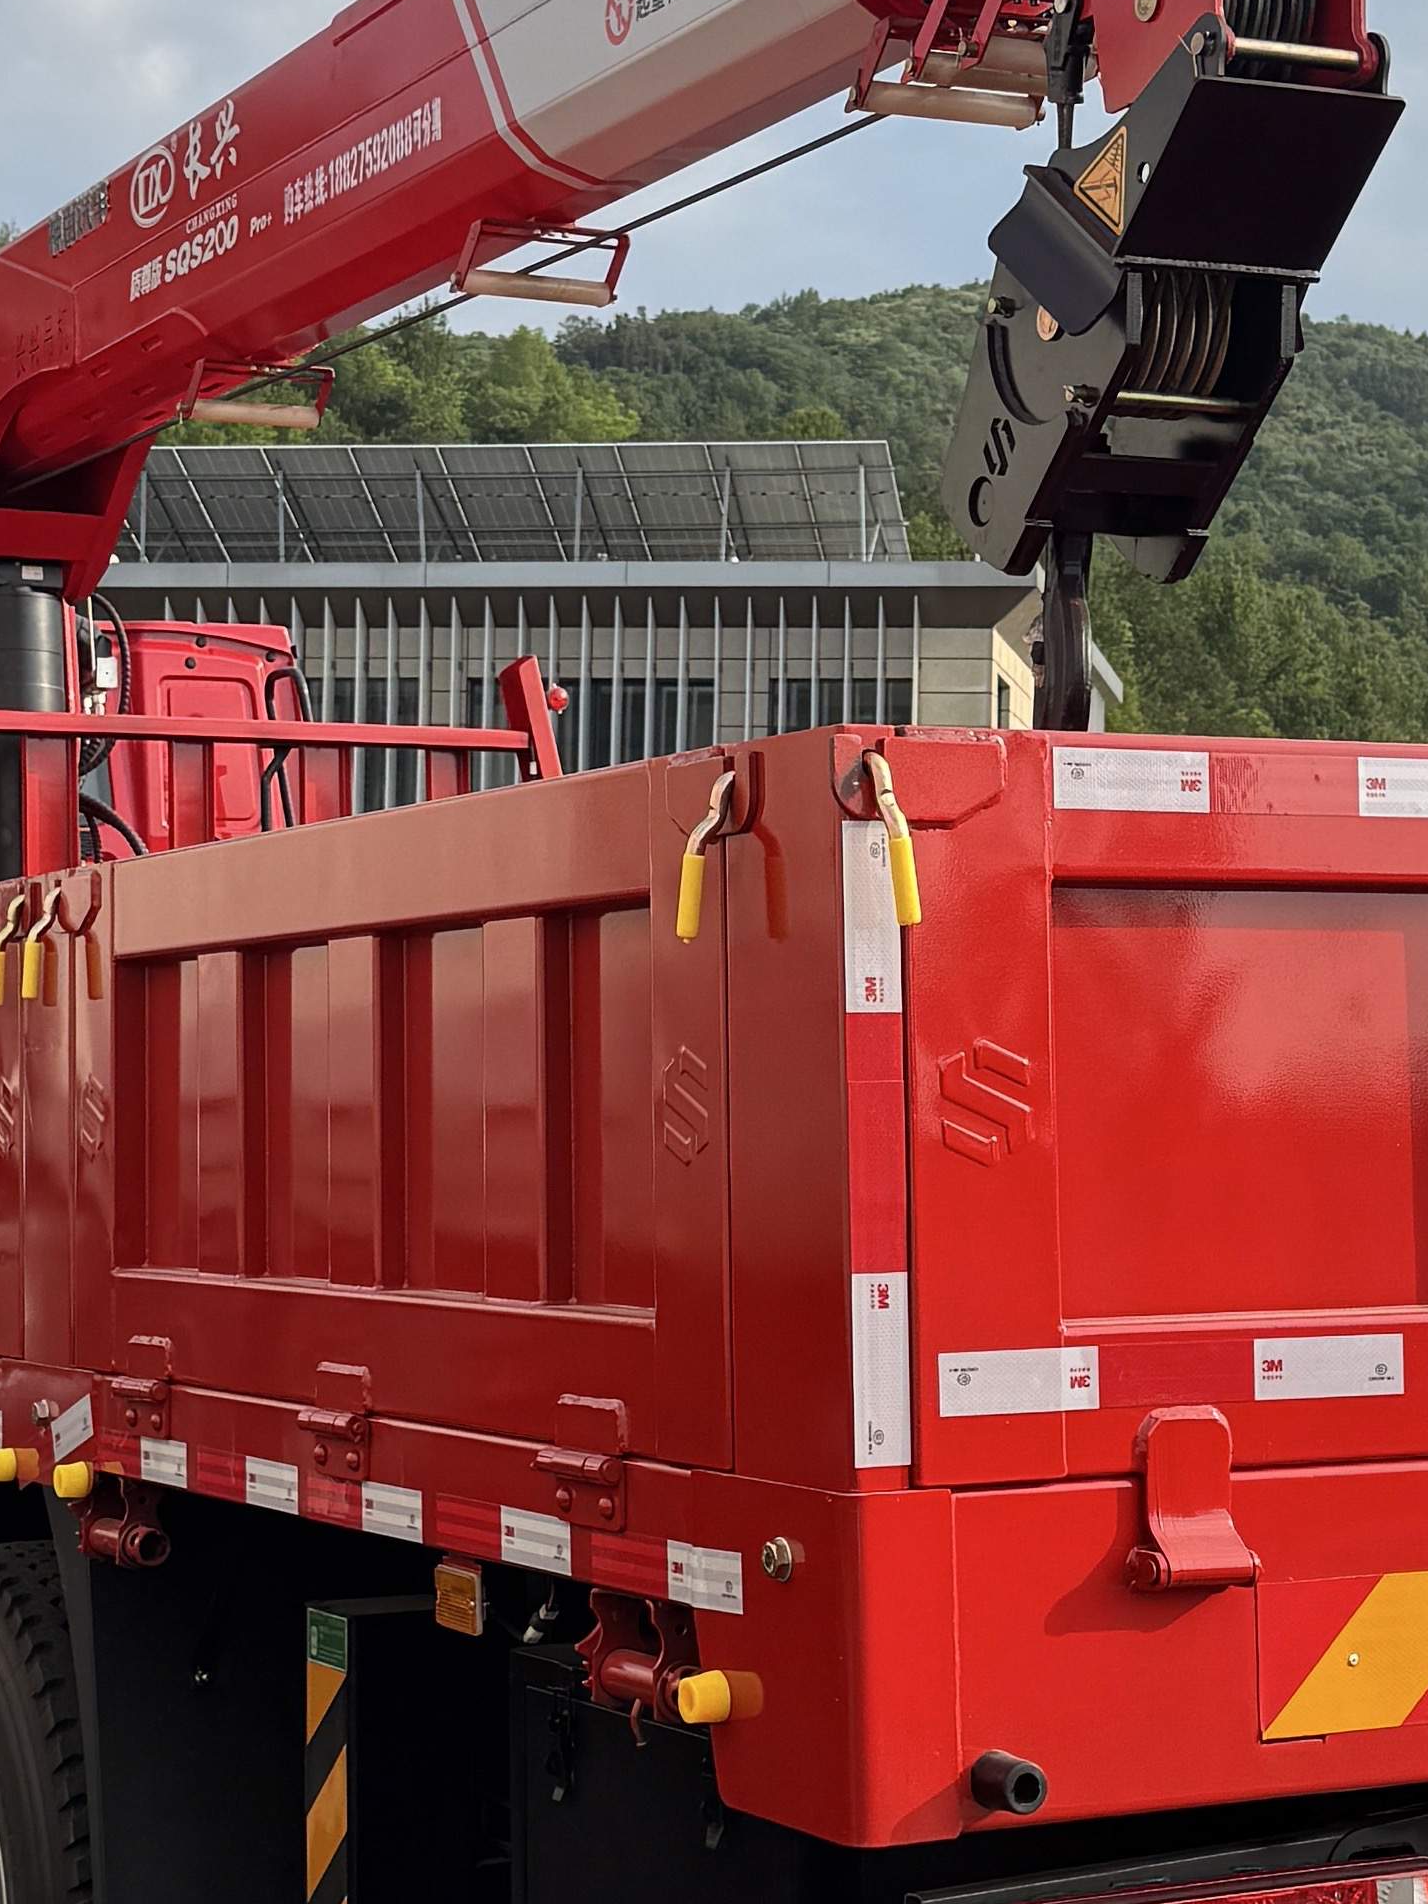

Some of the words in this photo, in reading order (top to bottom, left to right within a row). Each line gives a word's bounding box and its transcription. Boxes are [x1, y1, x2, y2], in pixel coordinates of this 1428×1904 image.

[183, 98, 240, 200] 长兴
[164, 215, 239, 283] SQS200
[1180, 778, 1203, 792] 3M
[1365, 777, 1387, 791] 3M
[865, 977, 876, 1002] 3M
[877, 1283, 890, 1309] 3M
[1262, 1360, 1283, 1373] 3M
[1070, 1375, 1091, 1389] 3M
